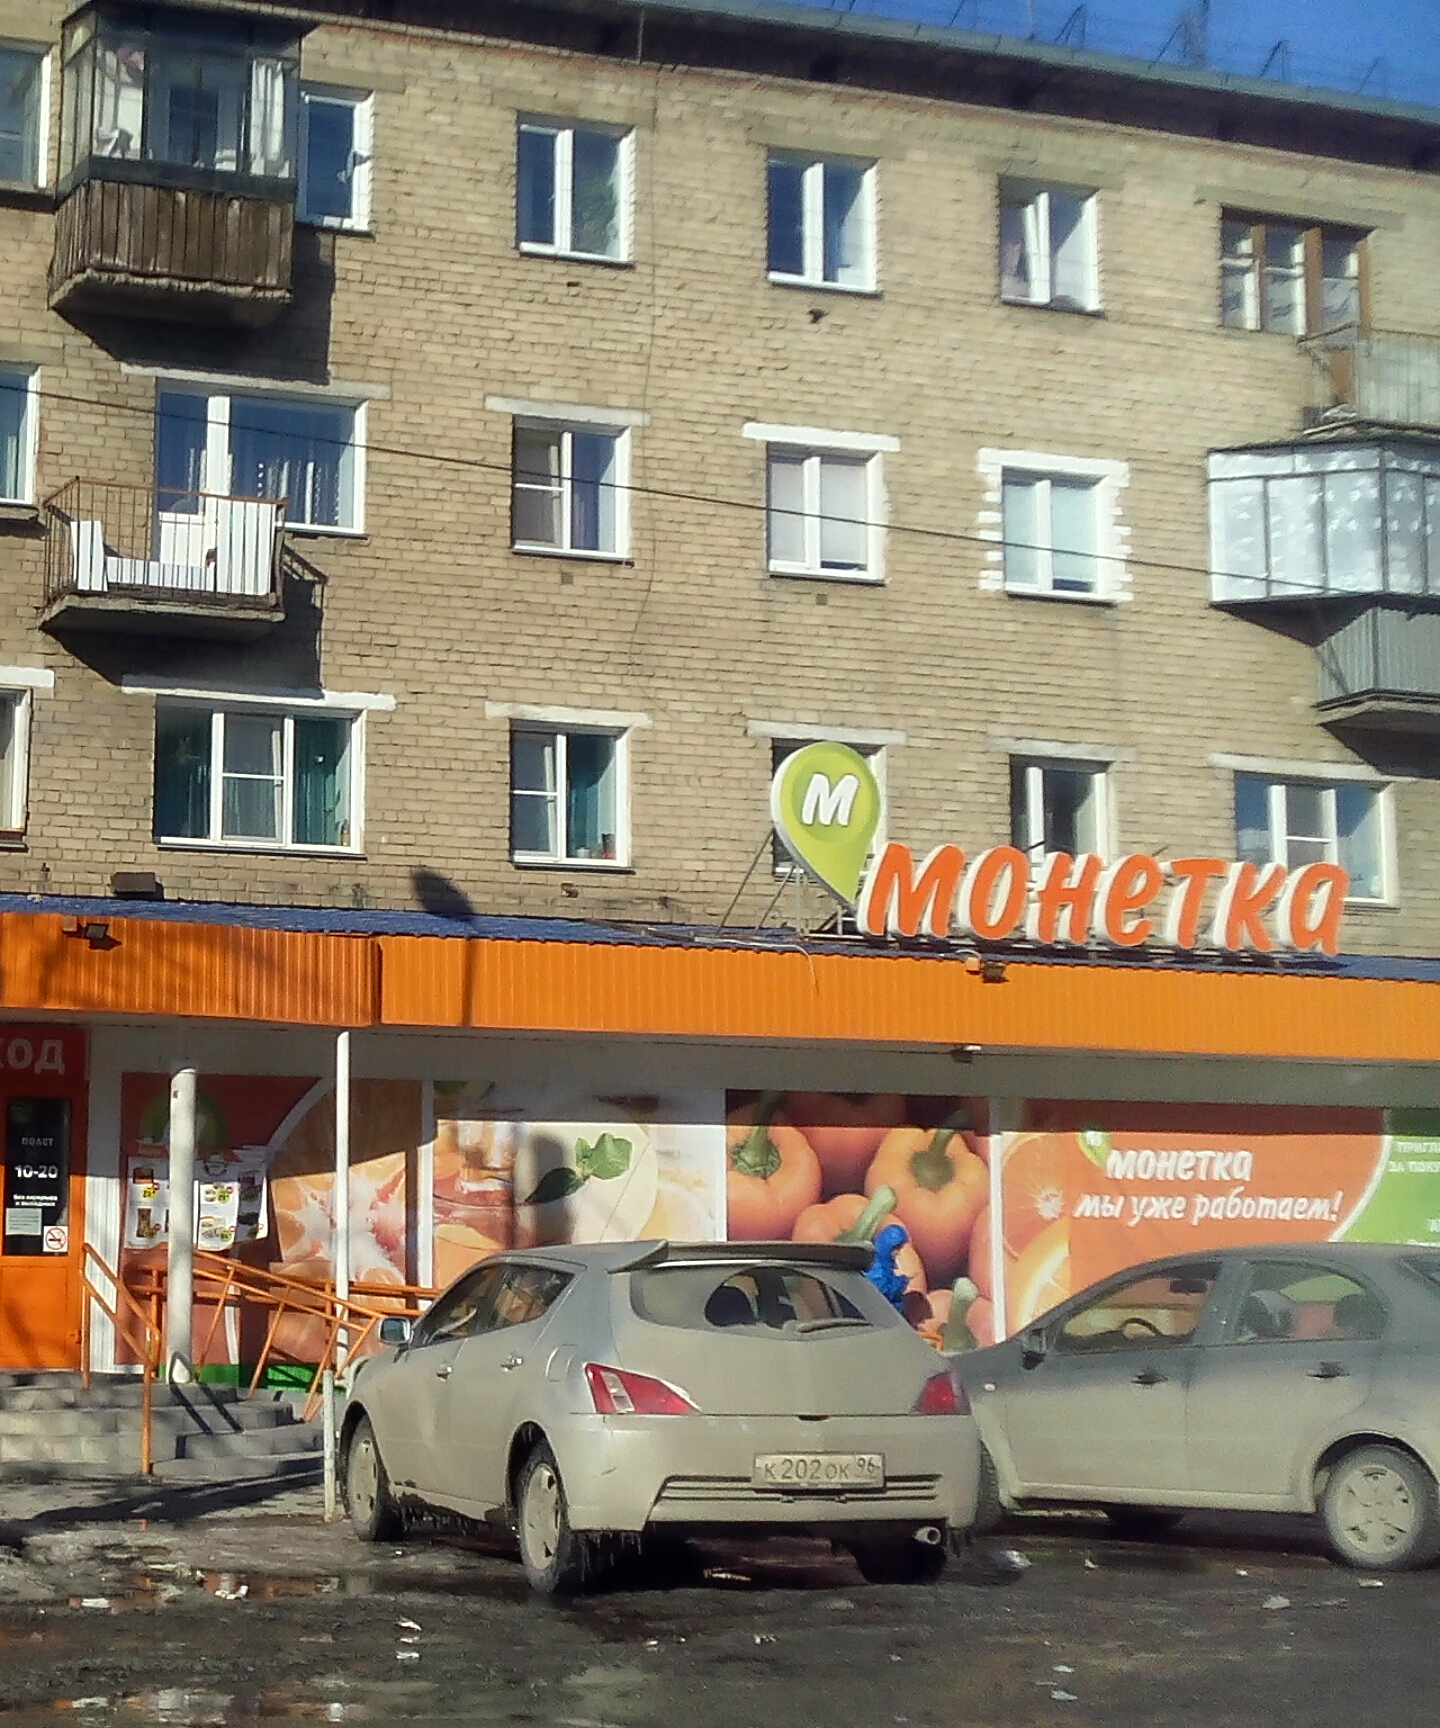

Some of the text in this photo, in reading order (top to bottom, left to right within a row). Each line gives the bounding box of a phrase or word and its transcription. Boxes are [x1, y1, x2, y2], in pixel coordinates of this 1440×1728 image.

[14, 1164, 59, 1179] 10-20
[1072, 1186, 1344, 1228] мы уже работаем!
[856, 1456, 874, 1475] 96
